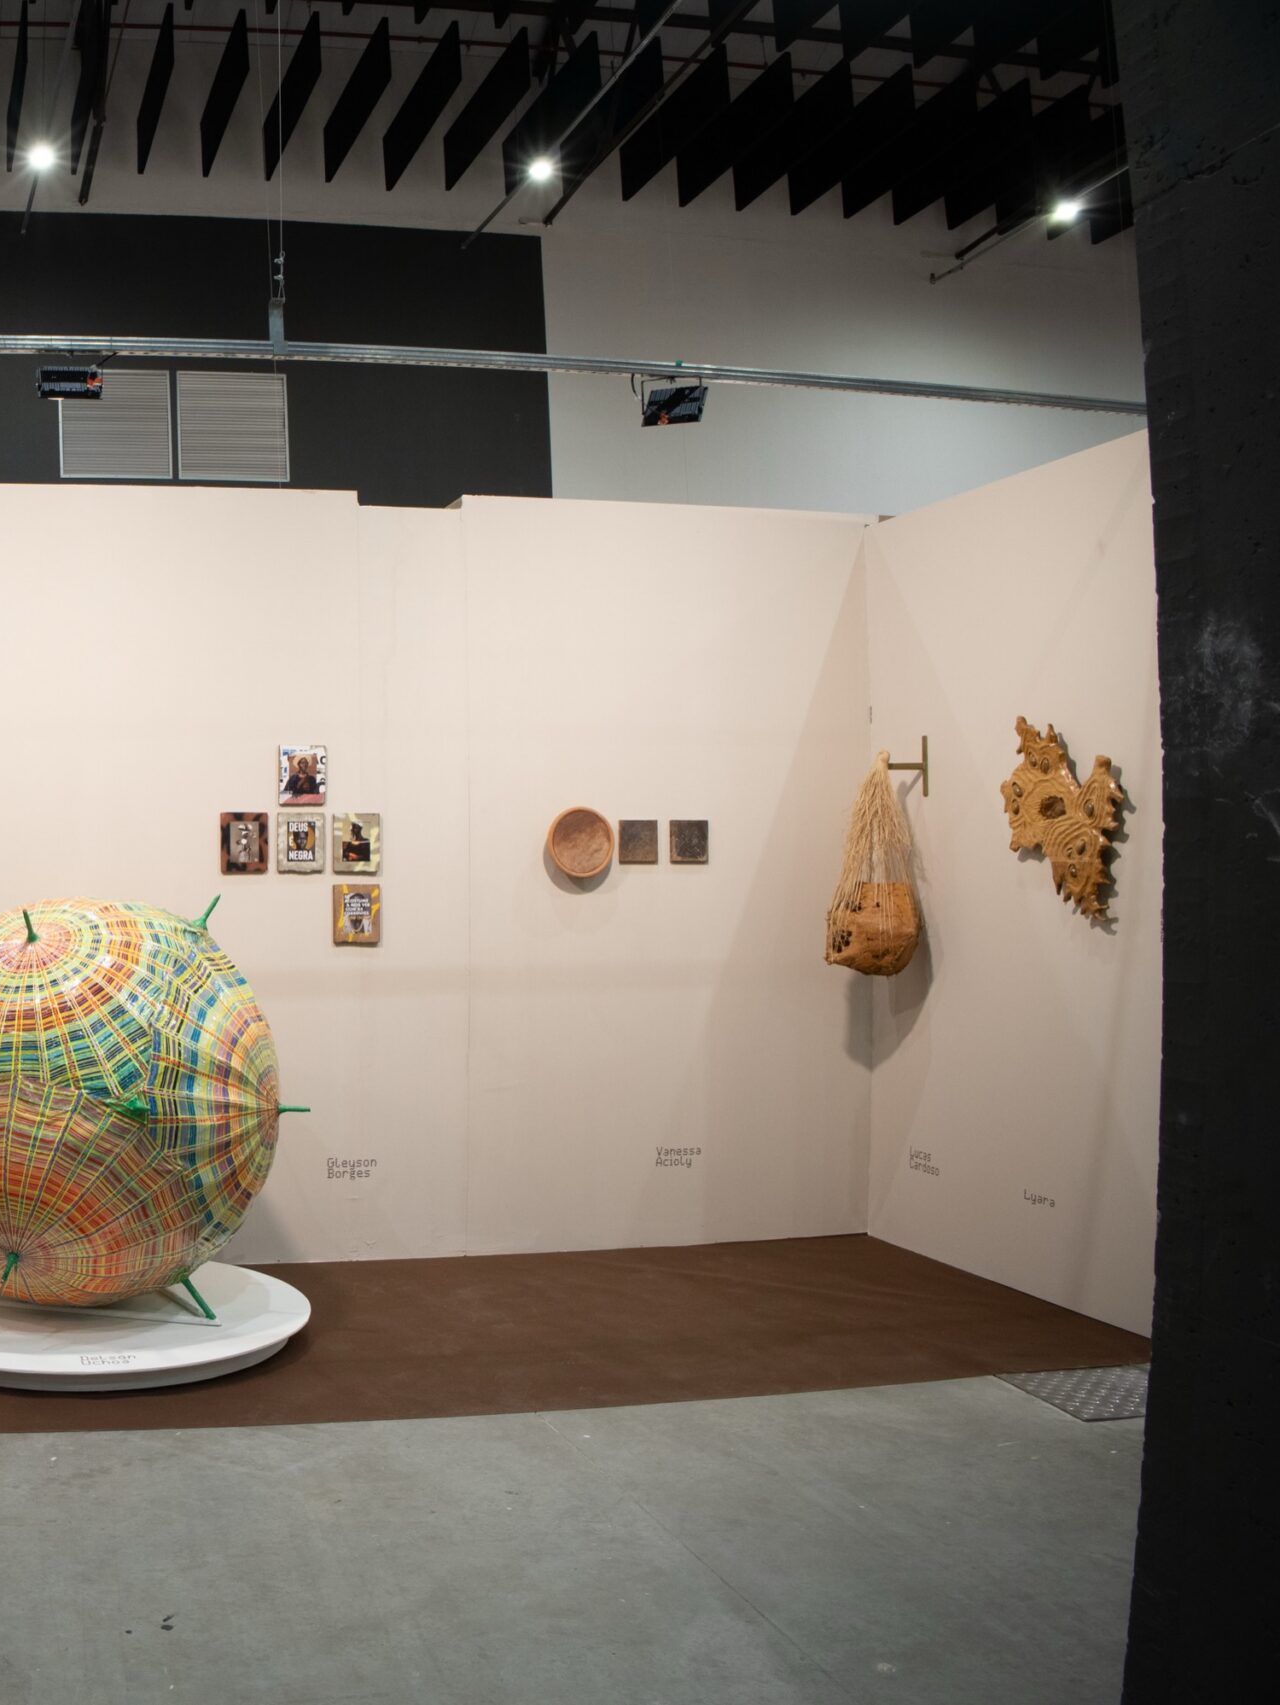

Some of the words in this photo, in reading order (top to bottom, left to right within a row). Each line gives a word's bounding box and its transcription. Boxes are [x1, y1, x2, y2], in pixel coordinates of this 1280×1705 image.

[288, 822, 309, 832] DEUS
[288, 850, 314, 861] NEGRA
[656, 1145, 702, 1157] Vanessa
[909, 1145, 932, 1162] Lucas
[327, 1157, 378, 1171] Gleyson
[655, 1156, 693, 1169] Acioly
[909, 1158, 940, 1177] Cardoso
[327, 1168, 371, 1181] Borges
[1023, 1188, 1056, 1208] Lyara
